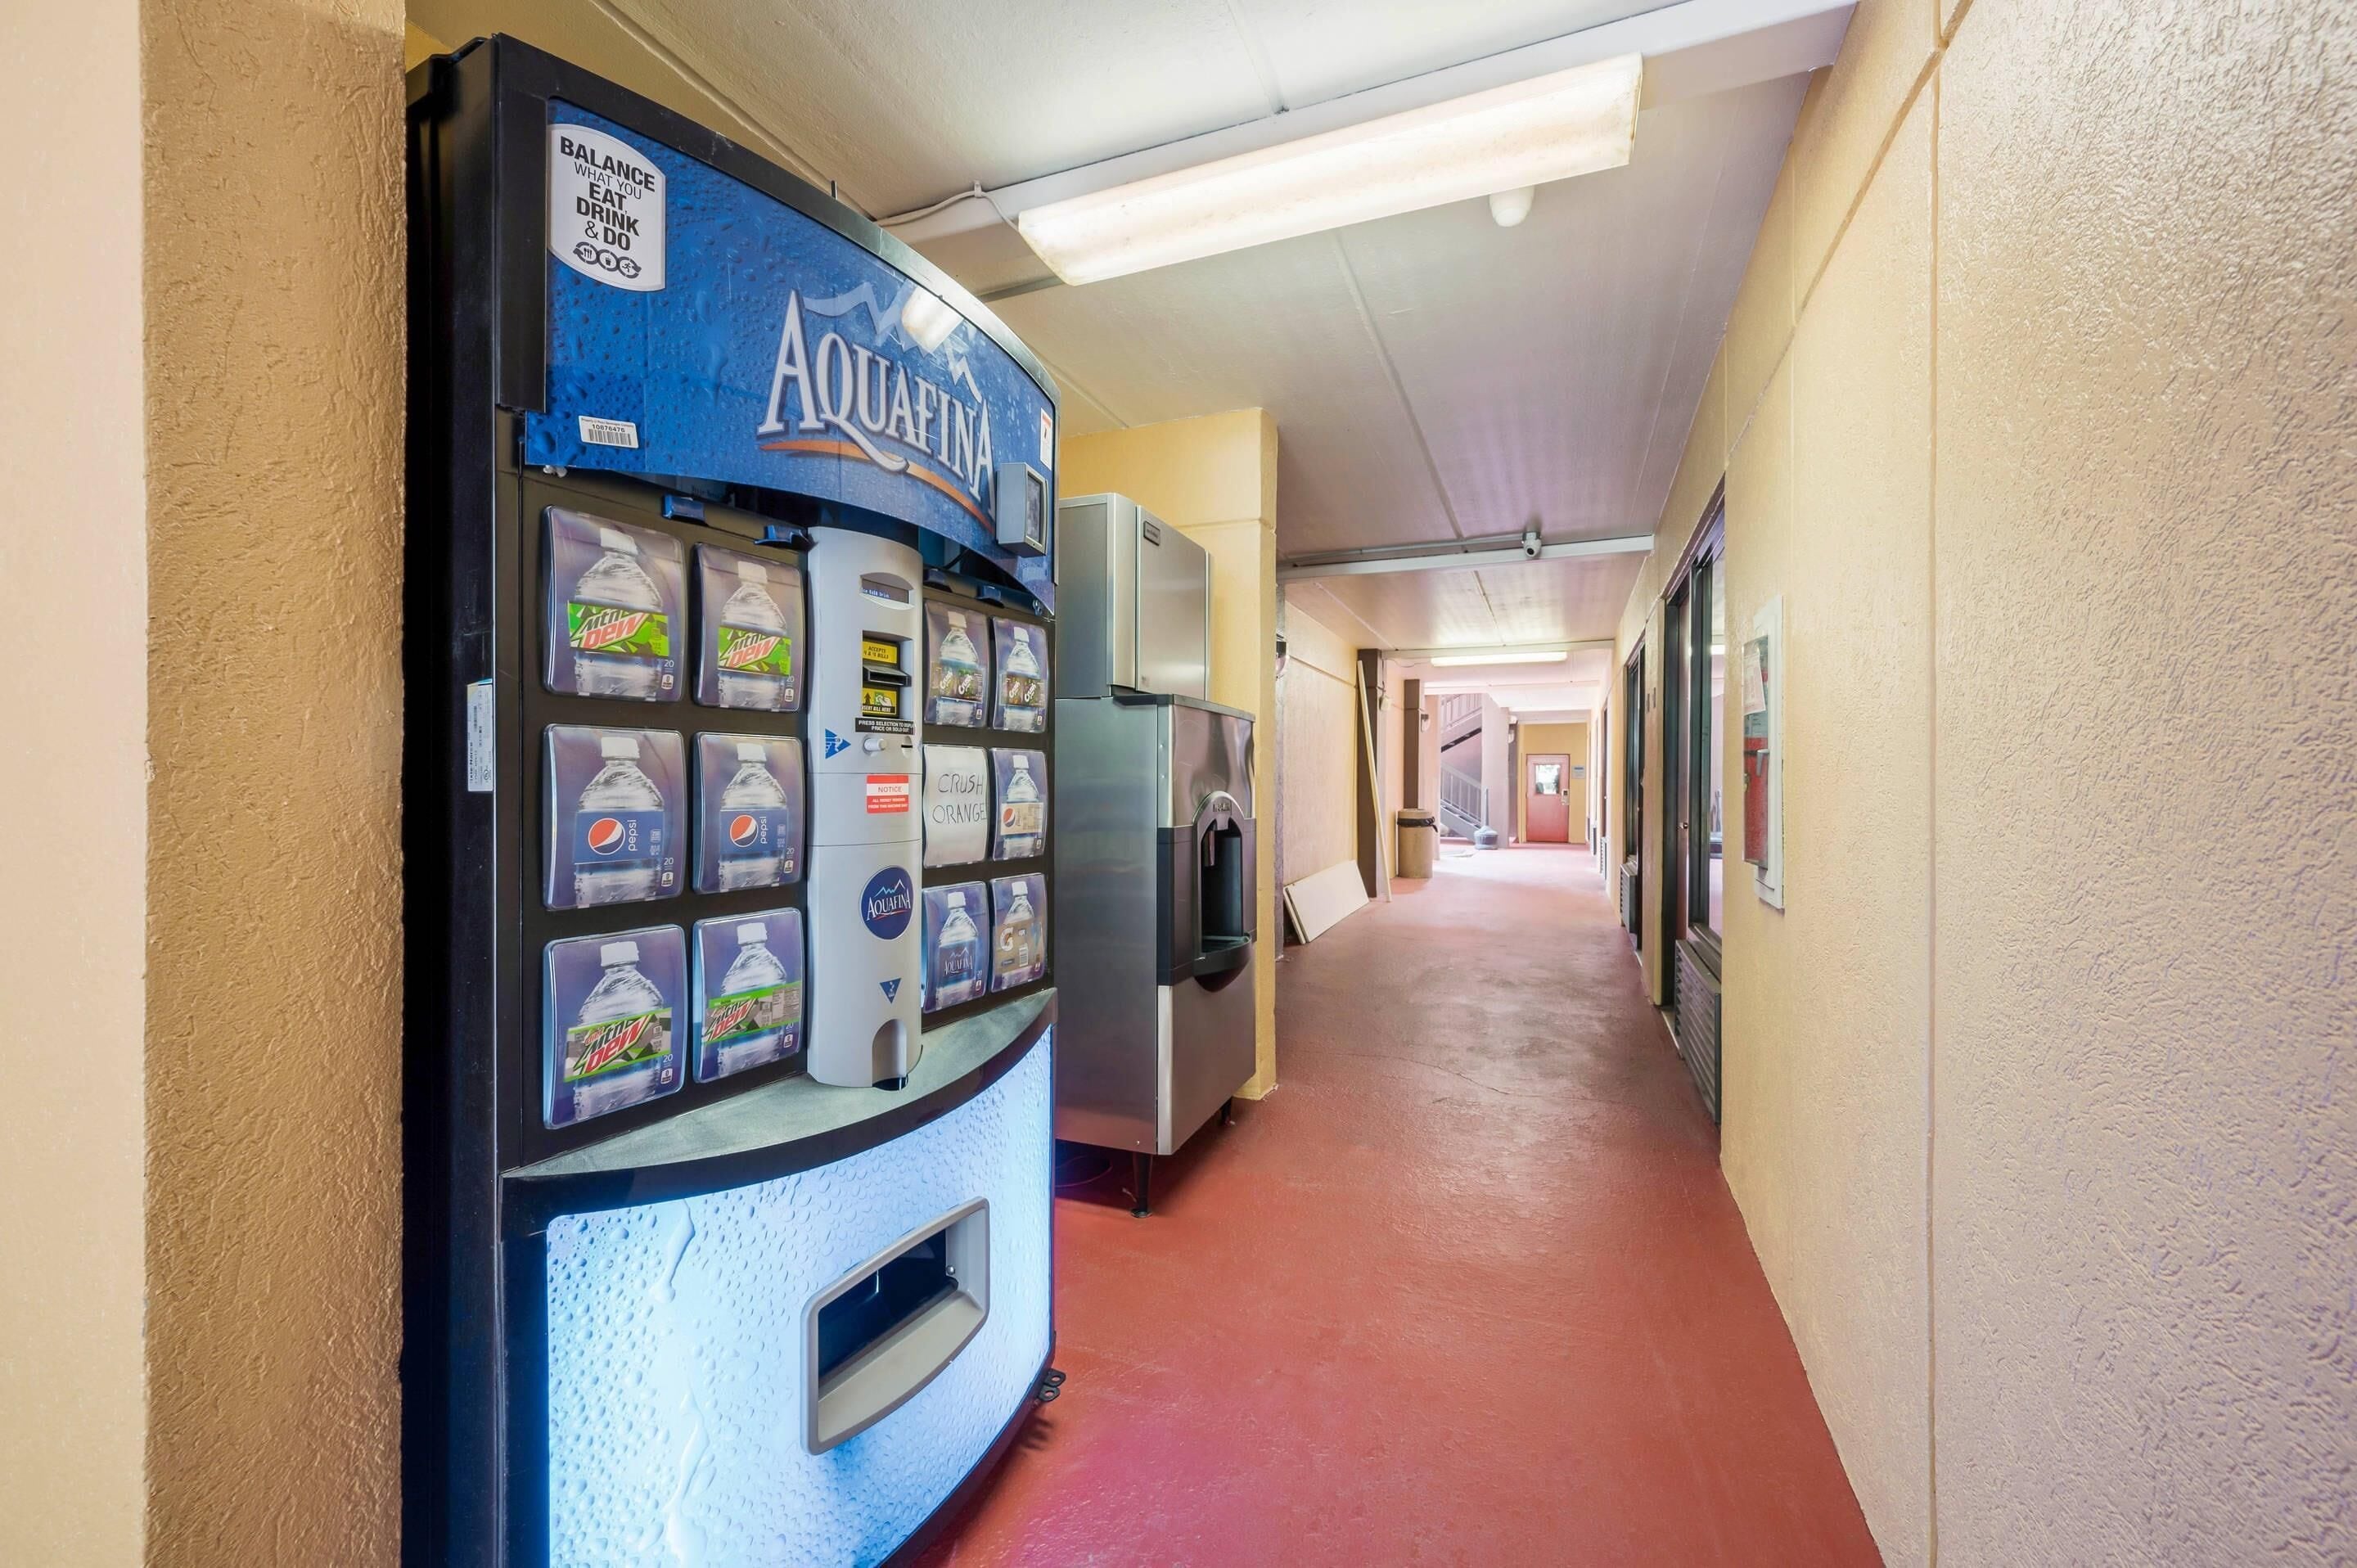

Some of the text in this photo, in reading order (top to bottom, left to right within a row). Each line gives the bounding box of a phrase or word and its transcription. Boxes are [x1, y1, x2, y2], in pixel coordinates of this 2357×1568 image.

[561, 136, 655, 192] BALANCE
[575, 161, 642, 200] WHAT YOU
[577, 196, 640, 237] DRINK
[585, 221, 630, 251] & DO
[758, 289, 996, 523] AQUAFINA
[665, 660, 674, 668] 20
[938, 773, 983, 795] CRUSH
[932, 803, 987, 824] ORANGE
[627, 819, 638, 851] pepsi
[759, 816, 768, 844] pepsi
[664, 857, 674, 865] 20
[866, 888, 911, 921] AQUAFINA
[663, 1053, 674, 1063] 20
